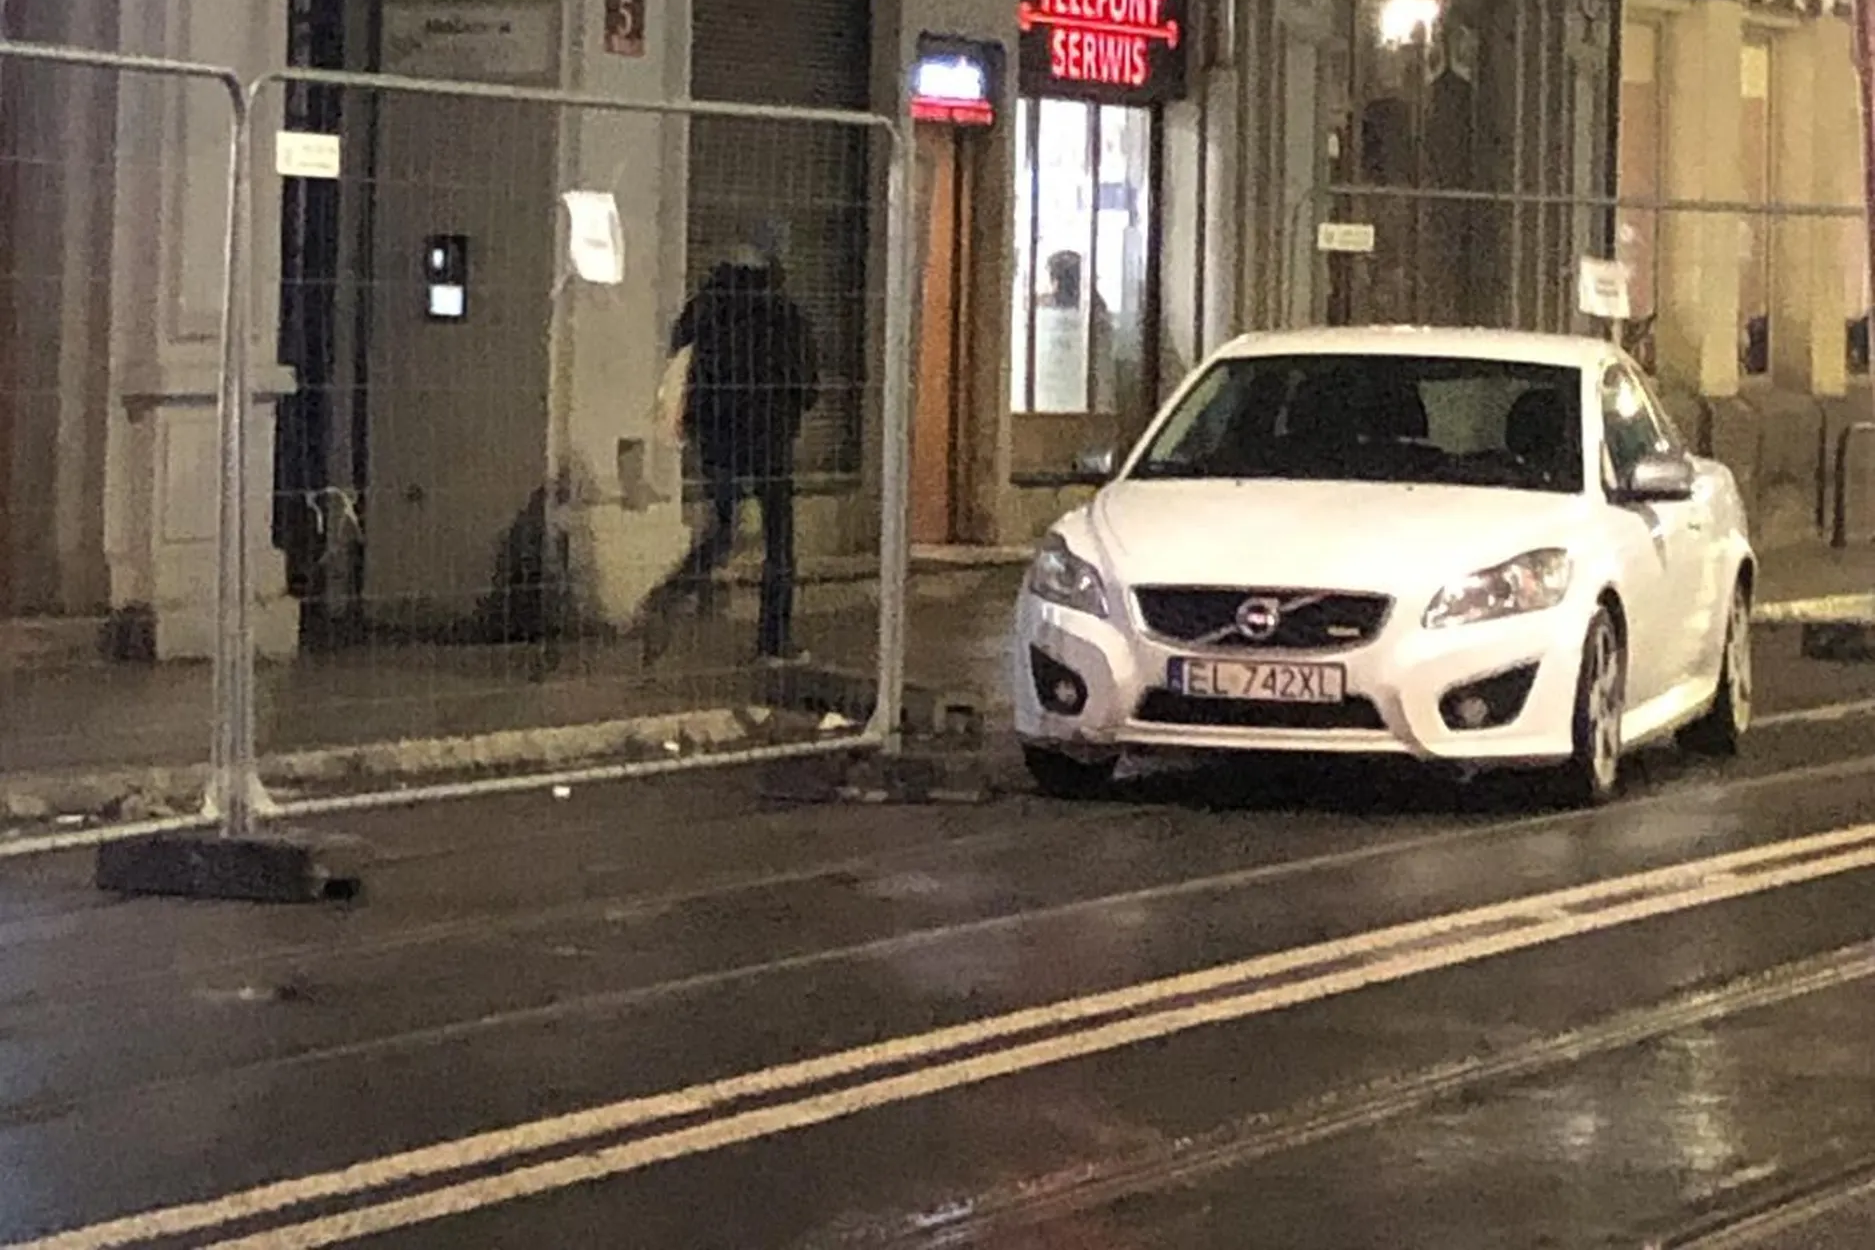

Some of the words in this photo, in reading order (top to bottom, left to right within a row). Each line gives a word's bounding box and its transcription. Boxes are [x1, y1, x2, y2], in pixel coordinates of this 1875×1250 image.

[1051, 28, 1148, 85] SERWIS
[1188, 660, 1228, 696] EL
[1242, 664, 1334, 700] 742XL
